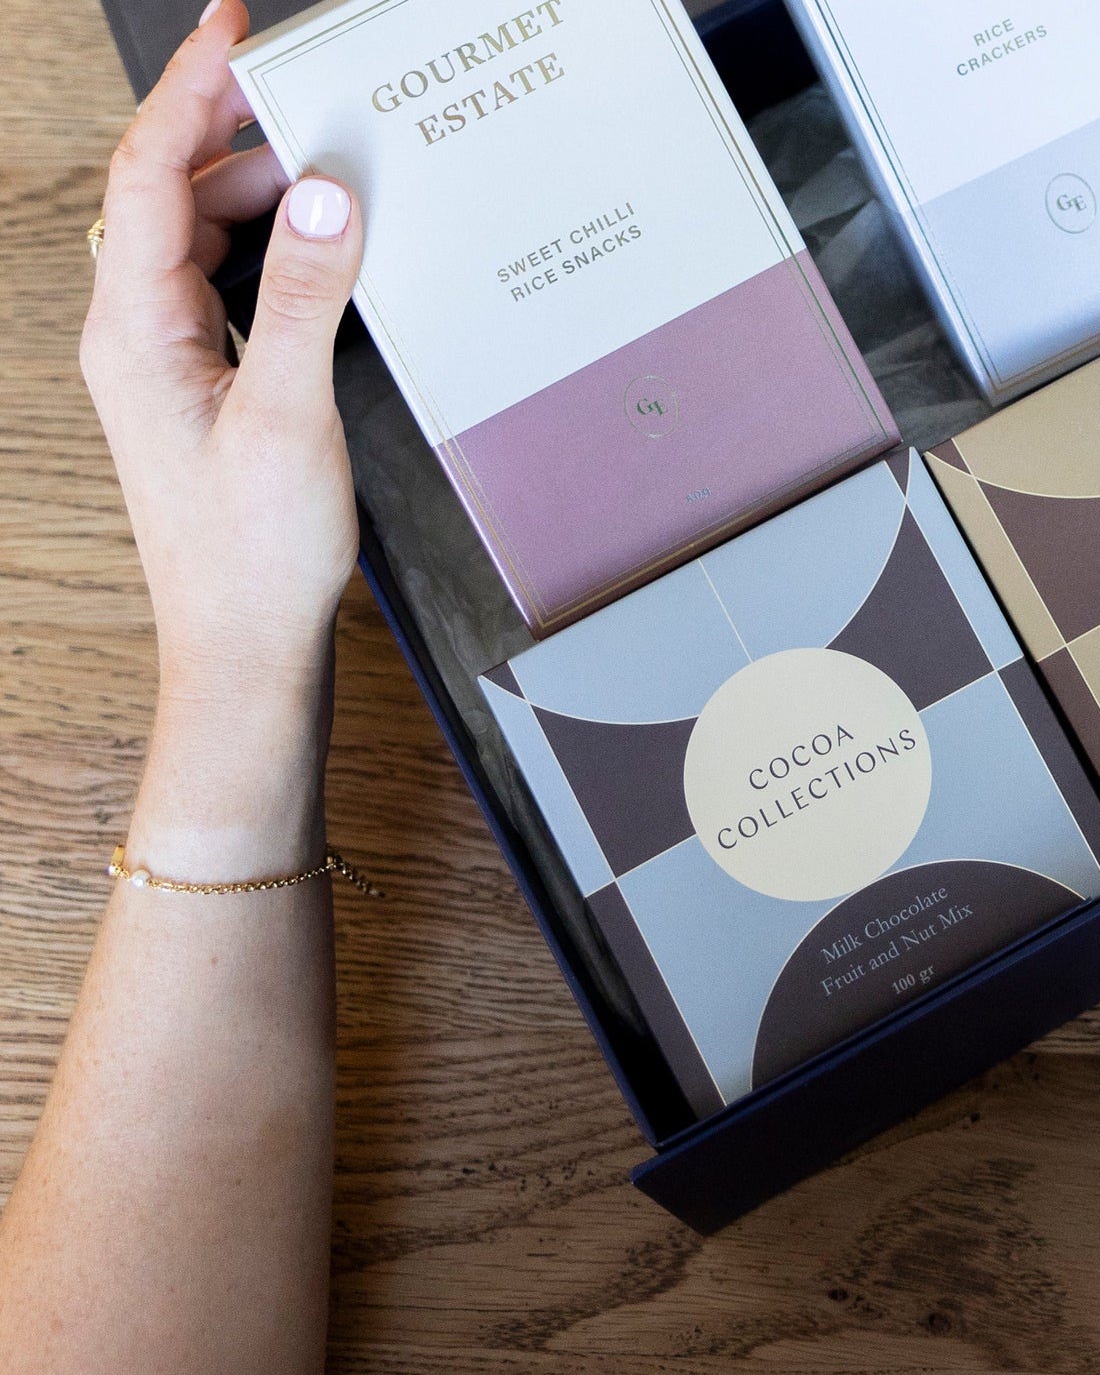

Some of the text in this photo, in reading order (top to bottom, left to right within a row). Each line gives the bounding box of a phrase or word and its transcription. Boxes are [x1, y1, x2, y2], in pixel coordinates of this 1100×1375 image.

[956, 25, 1047, 76] CRACKERS
[973, 18, 1015, 46] RICE
[415, 52, 565, 146] ESTATE
[497, 202, 635, 283] SWEET CHILLI
[510, 224, 642, 302] RICE SNACKS
[717, 729, 916, 849] COLLECTIONS
[749, 725, 854, 790] COCOA
[820, 887, 948, 964] Milk Chocolate
[820, 903, 974, 997] Fruit and Nut Mix
[892, 964, 935, 995] 100 gr
